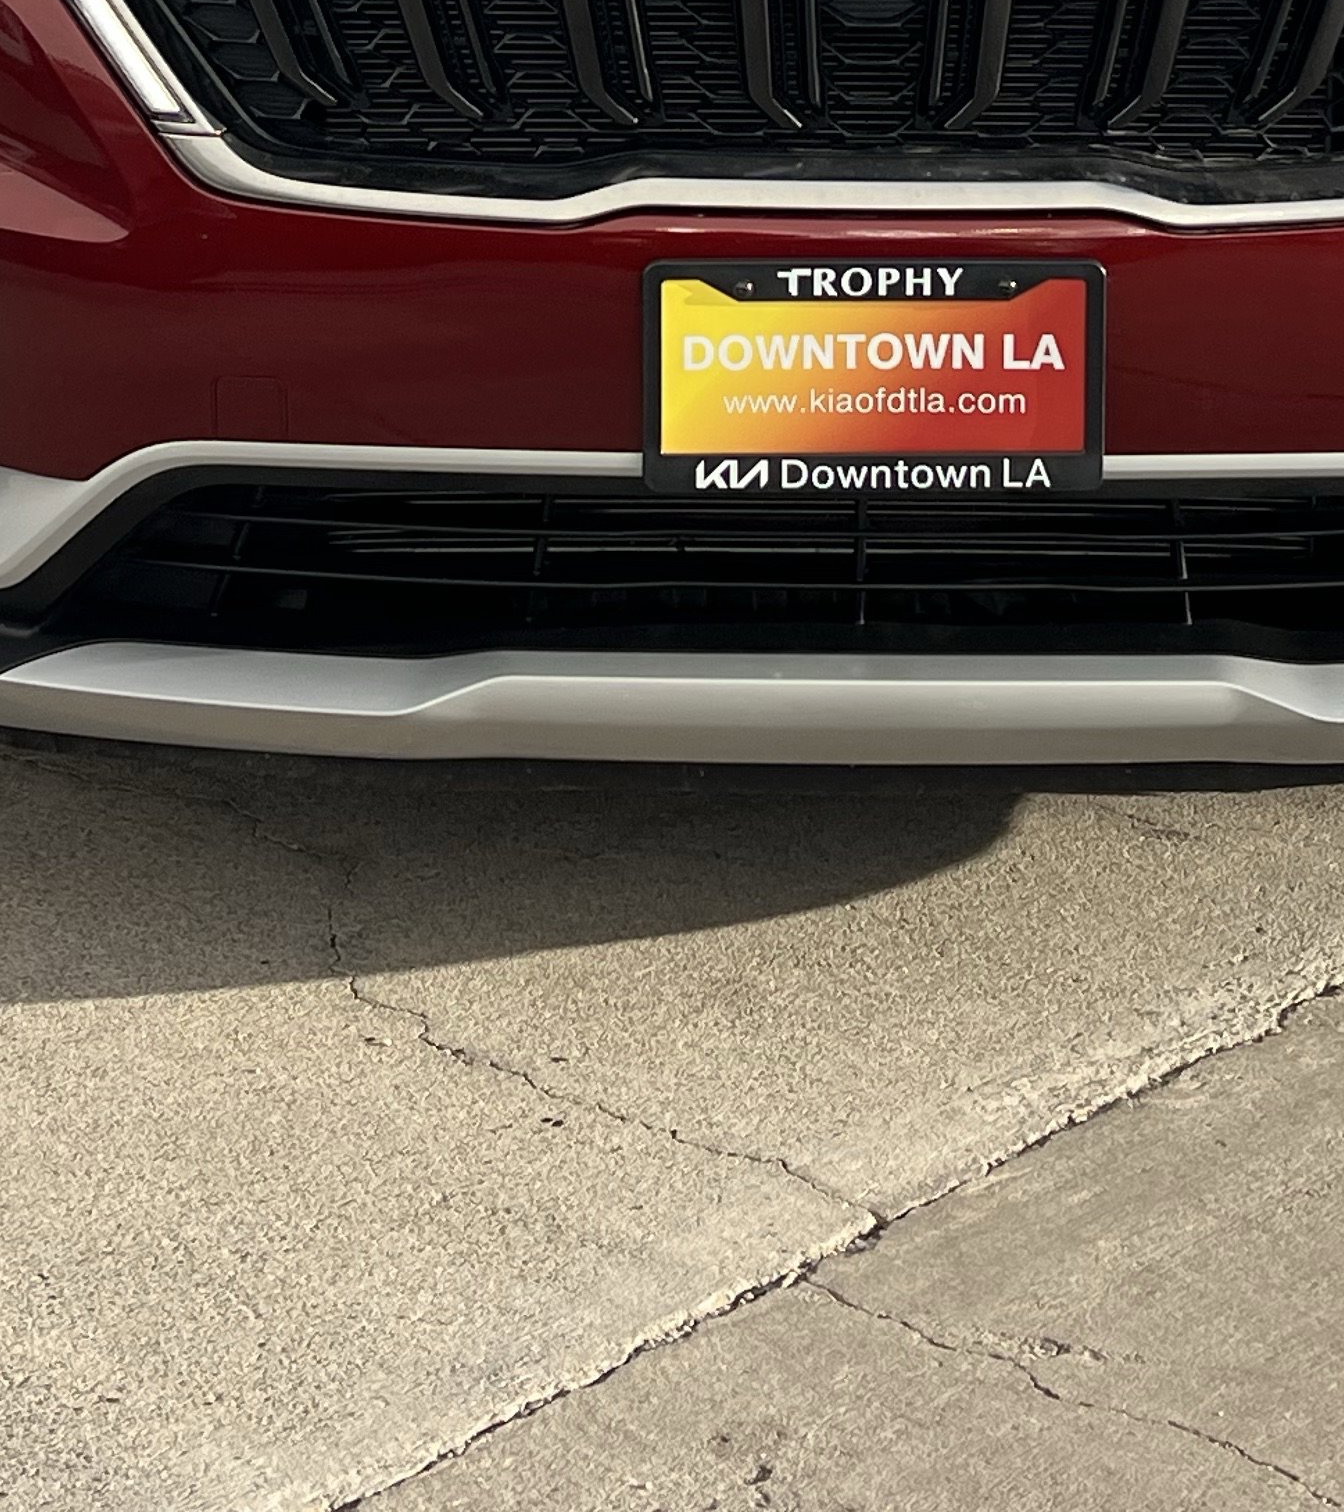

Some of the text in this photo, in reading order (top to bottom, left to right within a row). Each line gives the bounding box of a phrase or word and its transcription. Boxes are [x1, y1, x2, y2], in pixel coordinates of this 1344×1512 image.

[777, 267, 964, 297] TROPHY
[682, 333, 1066, 371] DOWNTOWN LA
[722, 387, 1027, 415] www.kiaofdtla.com
[695, 458, 1051, 490] KIA Downtown LA
